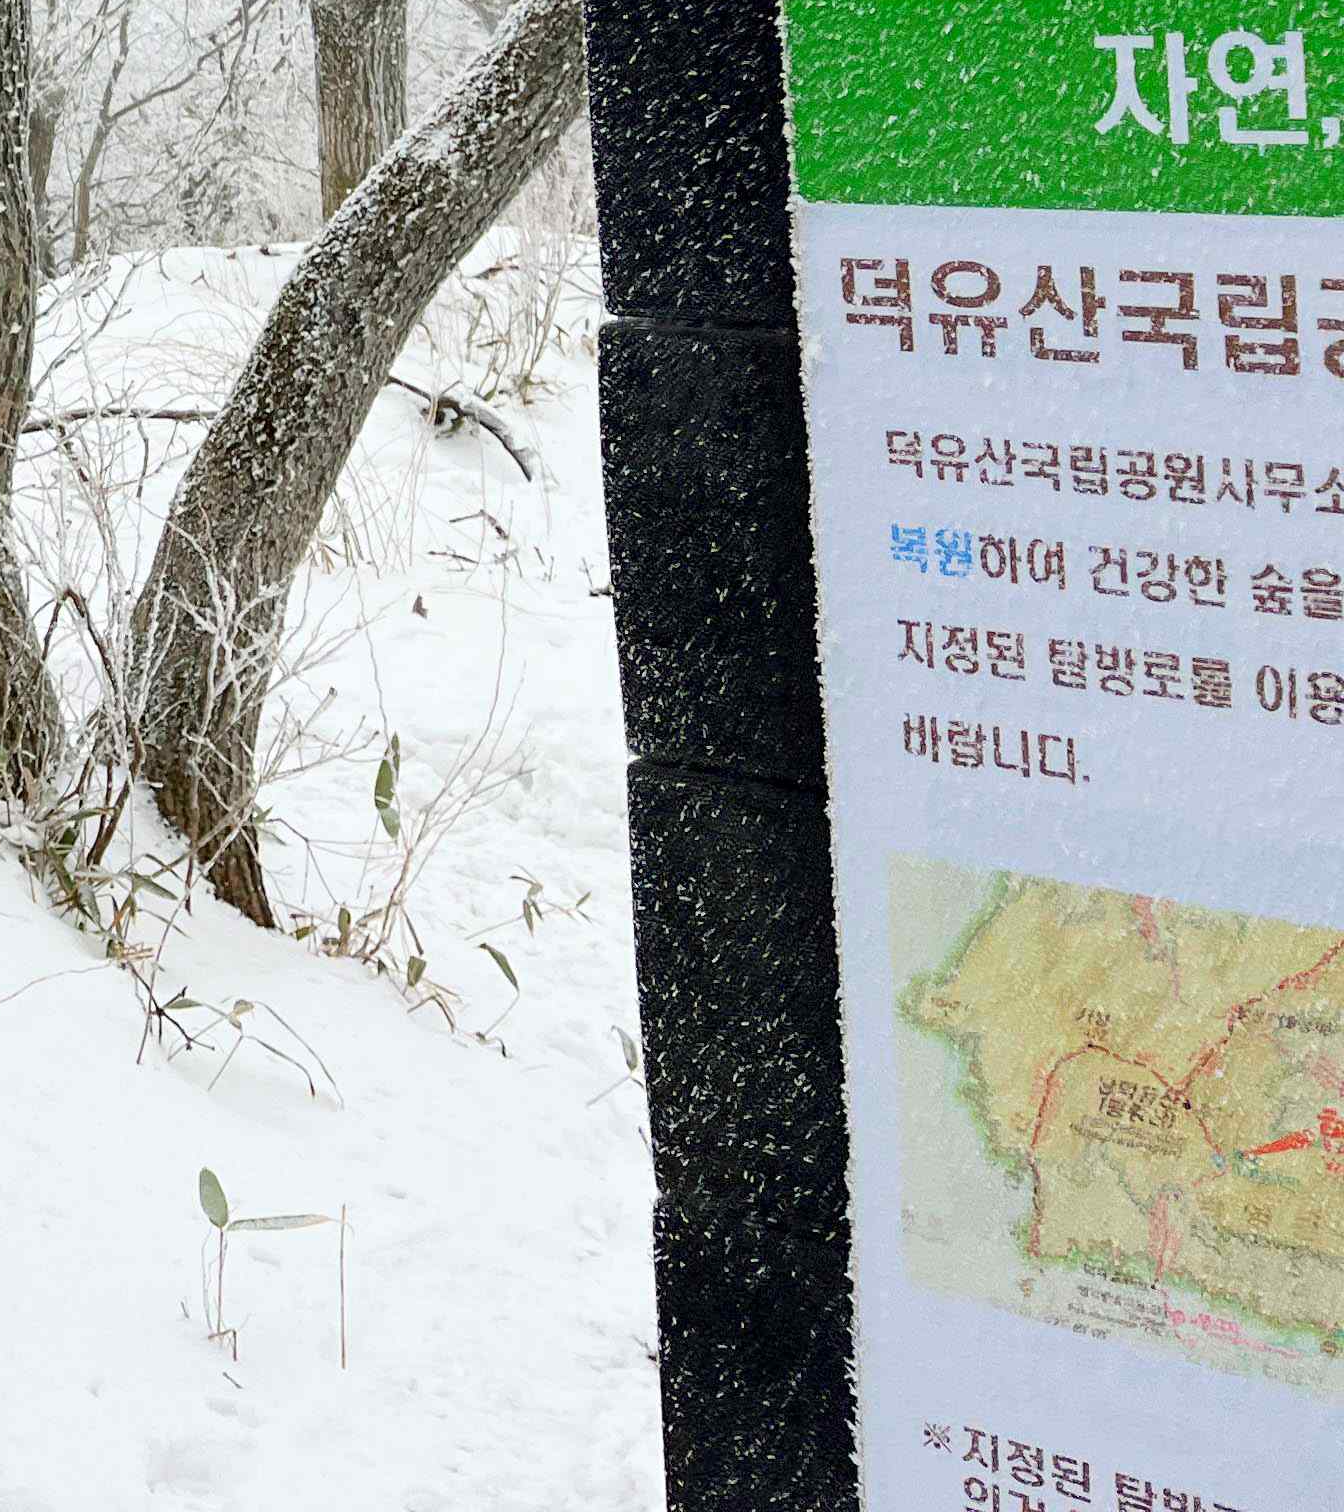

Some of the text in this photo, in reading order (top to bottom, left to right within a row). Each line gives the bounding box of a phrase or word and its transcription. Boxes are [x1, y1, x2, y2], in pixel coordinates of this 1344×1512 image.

[890, 521, 1067, 591] 복원하여
[1087, 544, 1227, 609] 건강한
[896, 618, 1026, 682] 지정된
[1047, 637, 1233, 709] 탐방로를
[902, 711, 1090, 785] 바랍니다.
